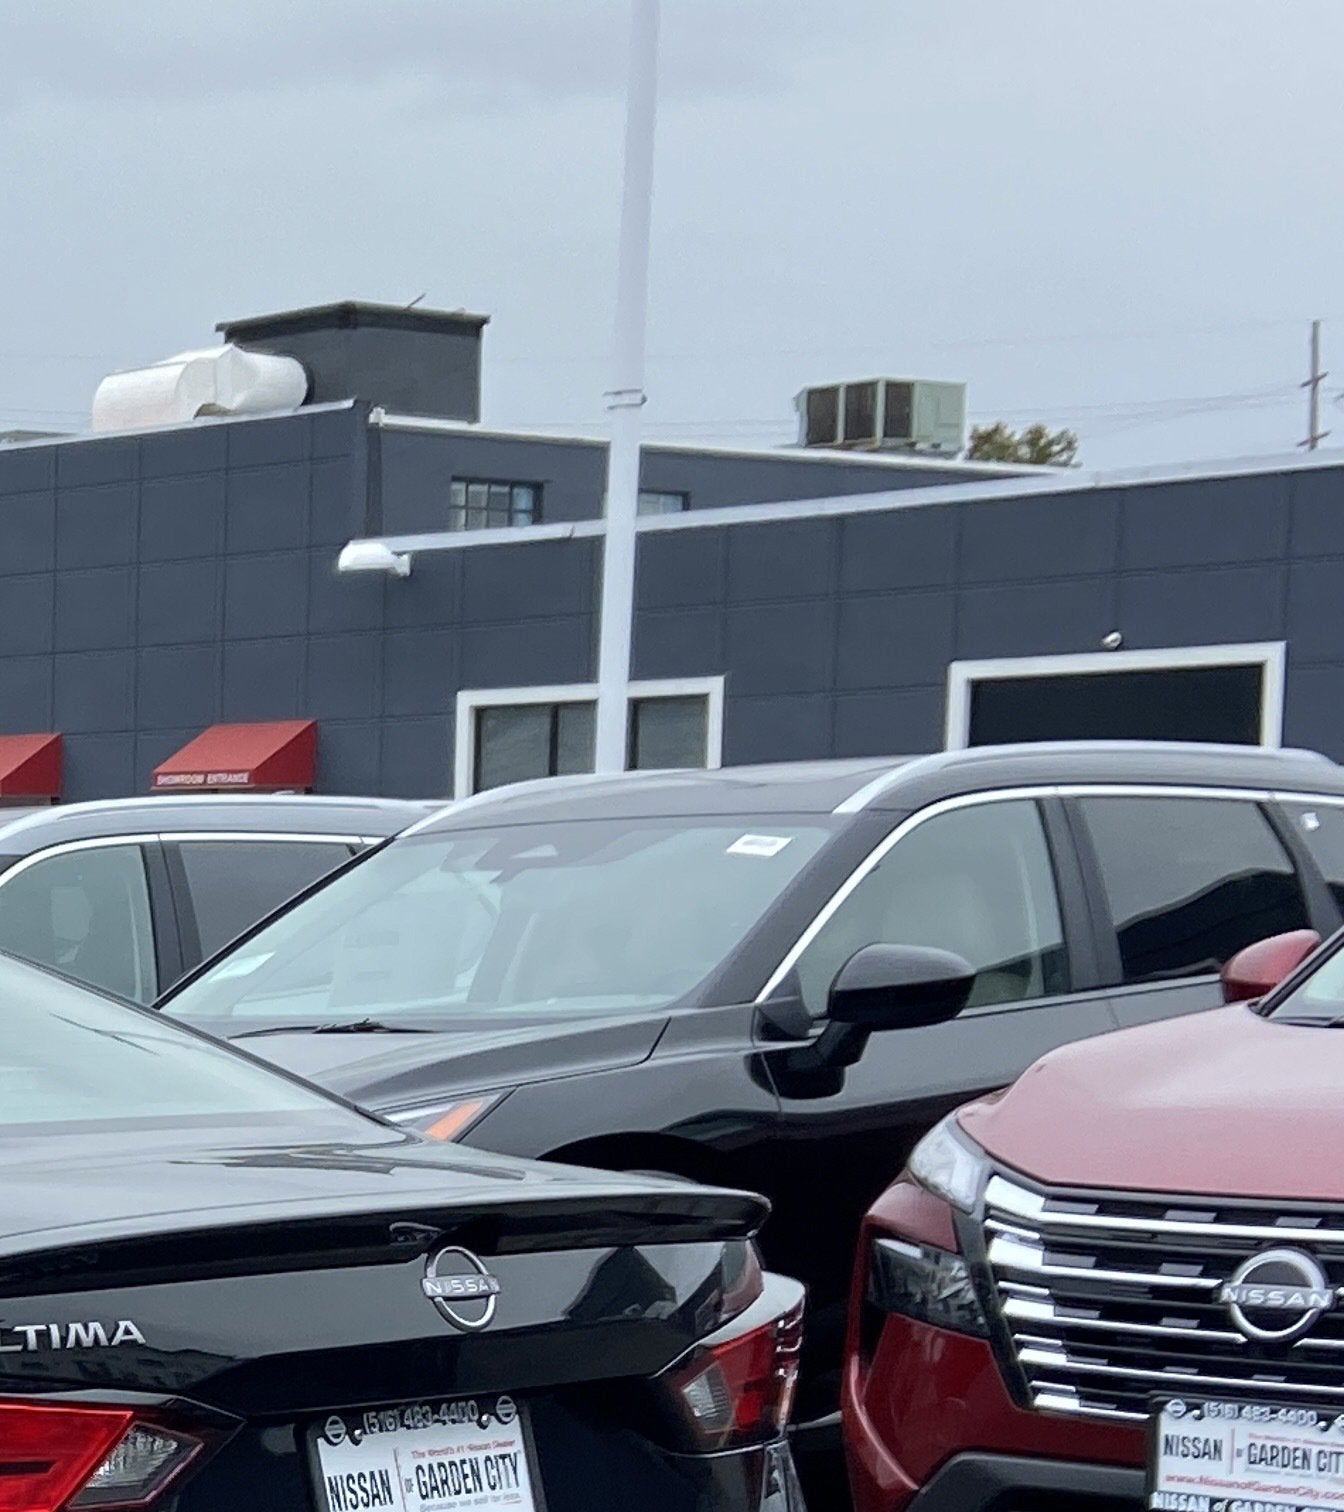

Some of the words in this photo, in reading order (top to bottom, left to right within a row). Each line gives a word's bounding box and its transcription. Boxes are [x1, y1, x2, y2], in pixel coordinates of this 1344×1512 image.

[425, 1279, 500, 1295] NISSAN
[1220, 1286, 1332, 1308] NISSAN
[1163, 1433, 1224, 1462] NISSAN
[1247, 1442, 1312, 1472] GARDEN
[327, 1468, 394, 1512] NISSAN
[415, 1456, 483, 1502] GARDEN
[484, 1451, 521, 1491] CITY
